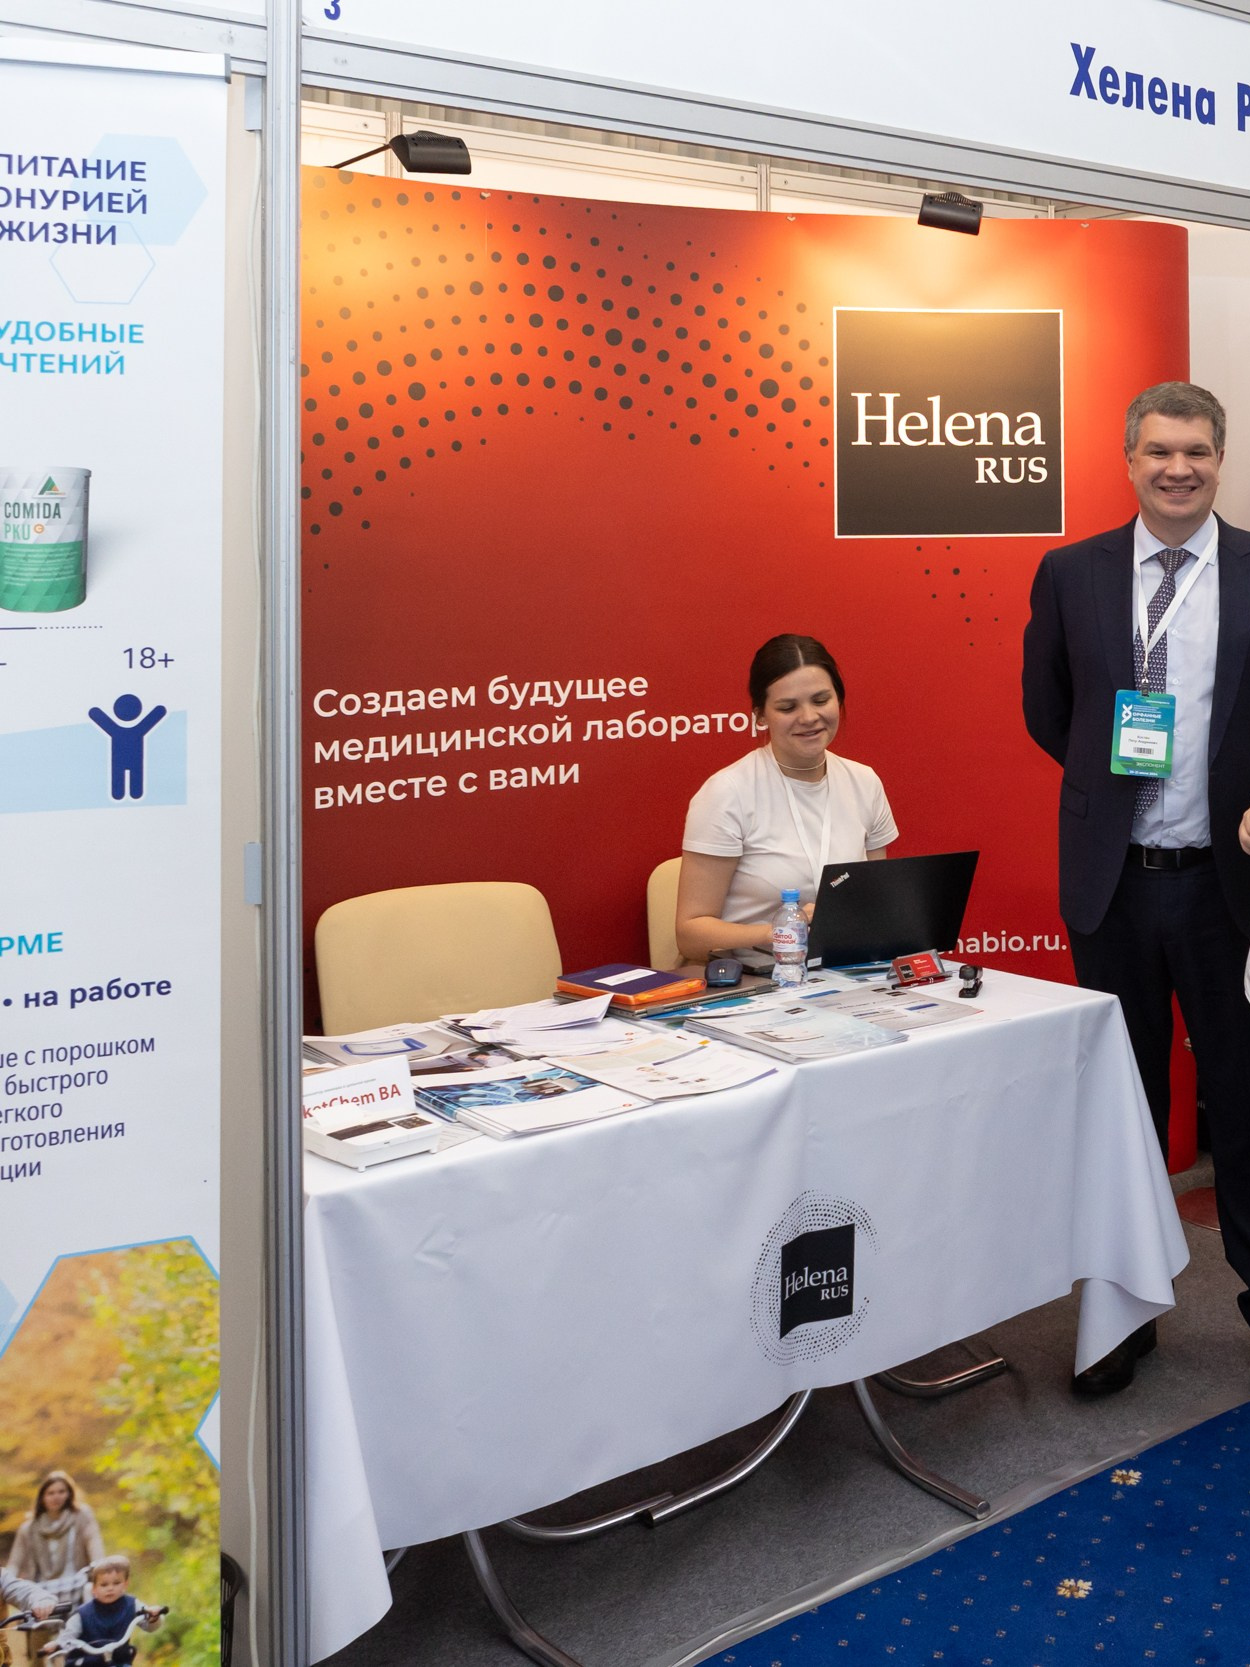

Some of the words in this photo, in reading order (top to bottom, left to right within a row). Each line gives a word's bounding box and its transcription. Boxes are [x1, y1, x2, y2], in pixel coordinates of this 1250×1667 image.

[1069, 42, 1216, 126] Хелена
[0, 153, 147, 182] ПИТАНИЕ
[0, 220, 117, 246] ЖИЗНИ
[0, 350, 125, 375] ЧТЕНИЙ
[851, 392, 1045, 446] Helena
[975, 456, 1048, 484] RUS
[5, 502, 61, 519] COMIDA
[5, 523, 31, 540] PKU
[124, 647, 175, 669] 18+
[313, 685, 477, 718] Создаем
[487, 674, 649, 708] будущее
[314, 714, 573, 763] медицинской
[314, 774, 448, 809] вместе
[458, 770, 478, 793] с
[489, 763, 580, 791] вами
[24, 990, 59, 1008] на
[70, 977, 172, 1009] работе
[25, 1050, 36, 1066] с
[42, 1037, 155, 1065] порошком
[5, 1069, 108, 1096] быстрого
[379, 1084, 401, 1101] BA
[1, 1122, 125, 1152] готовления
[0, 1161, 42, 1182] ции
[784, 1266, 848, 1300] Helena
[821, 1284, 849, 1301] RUS
